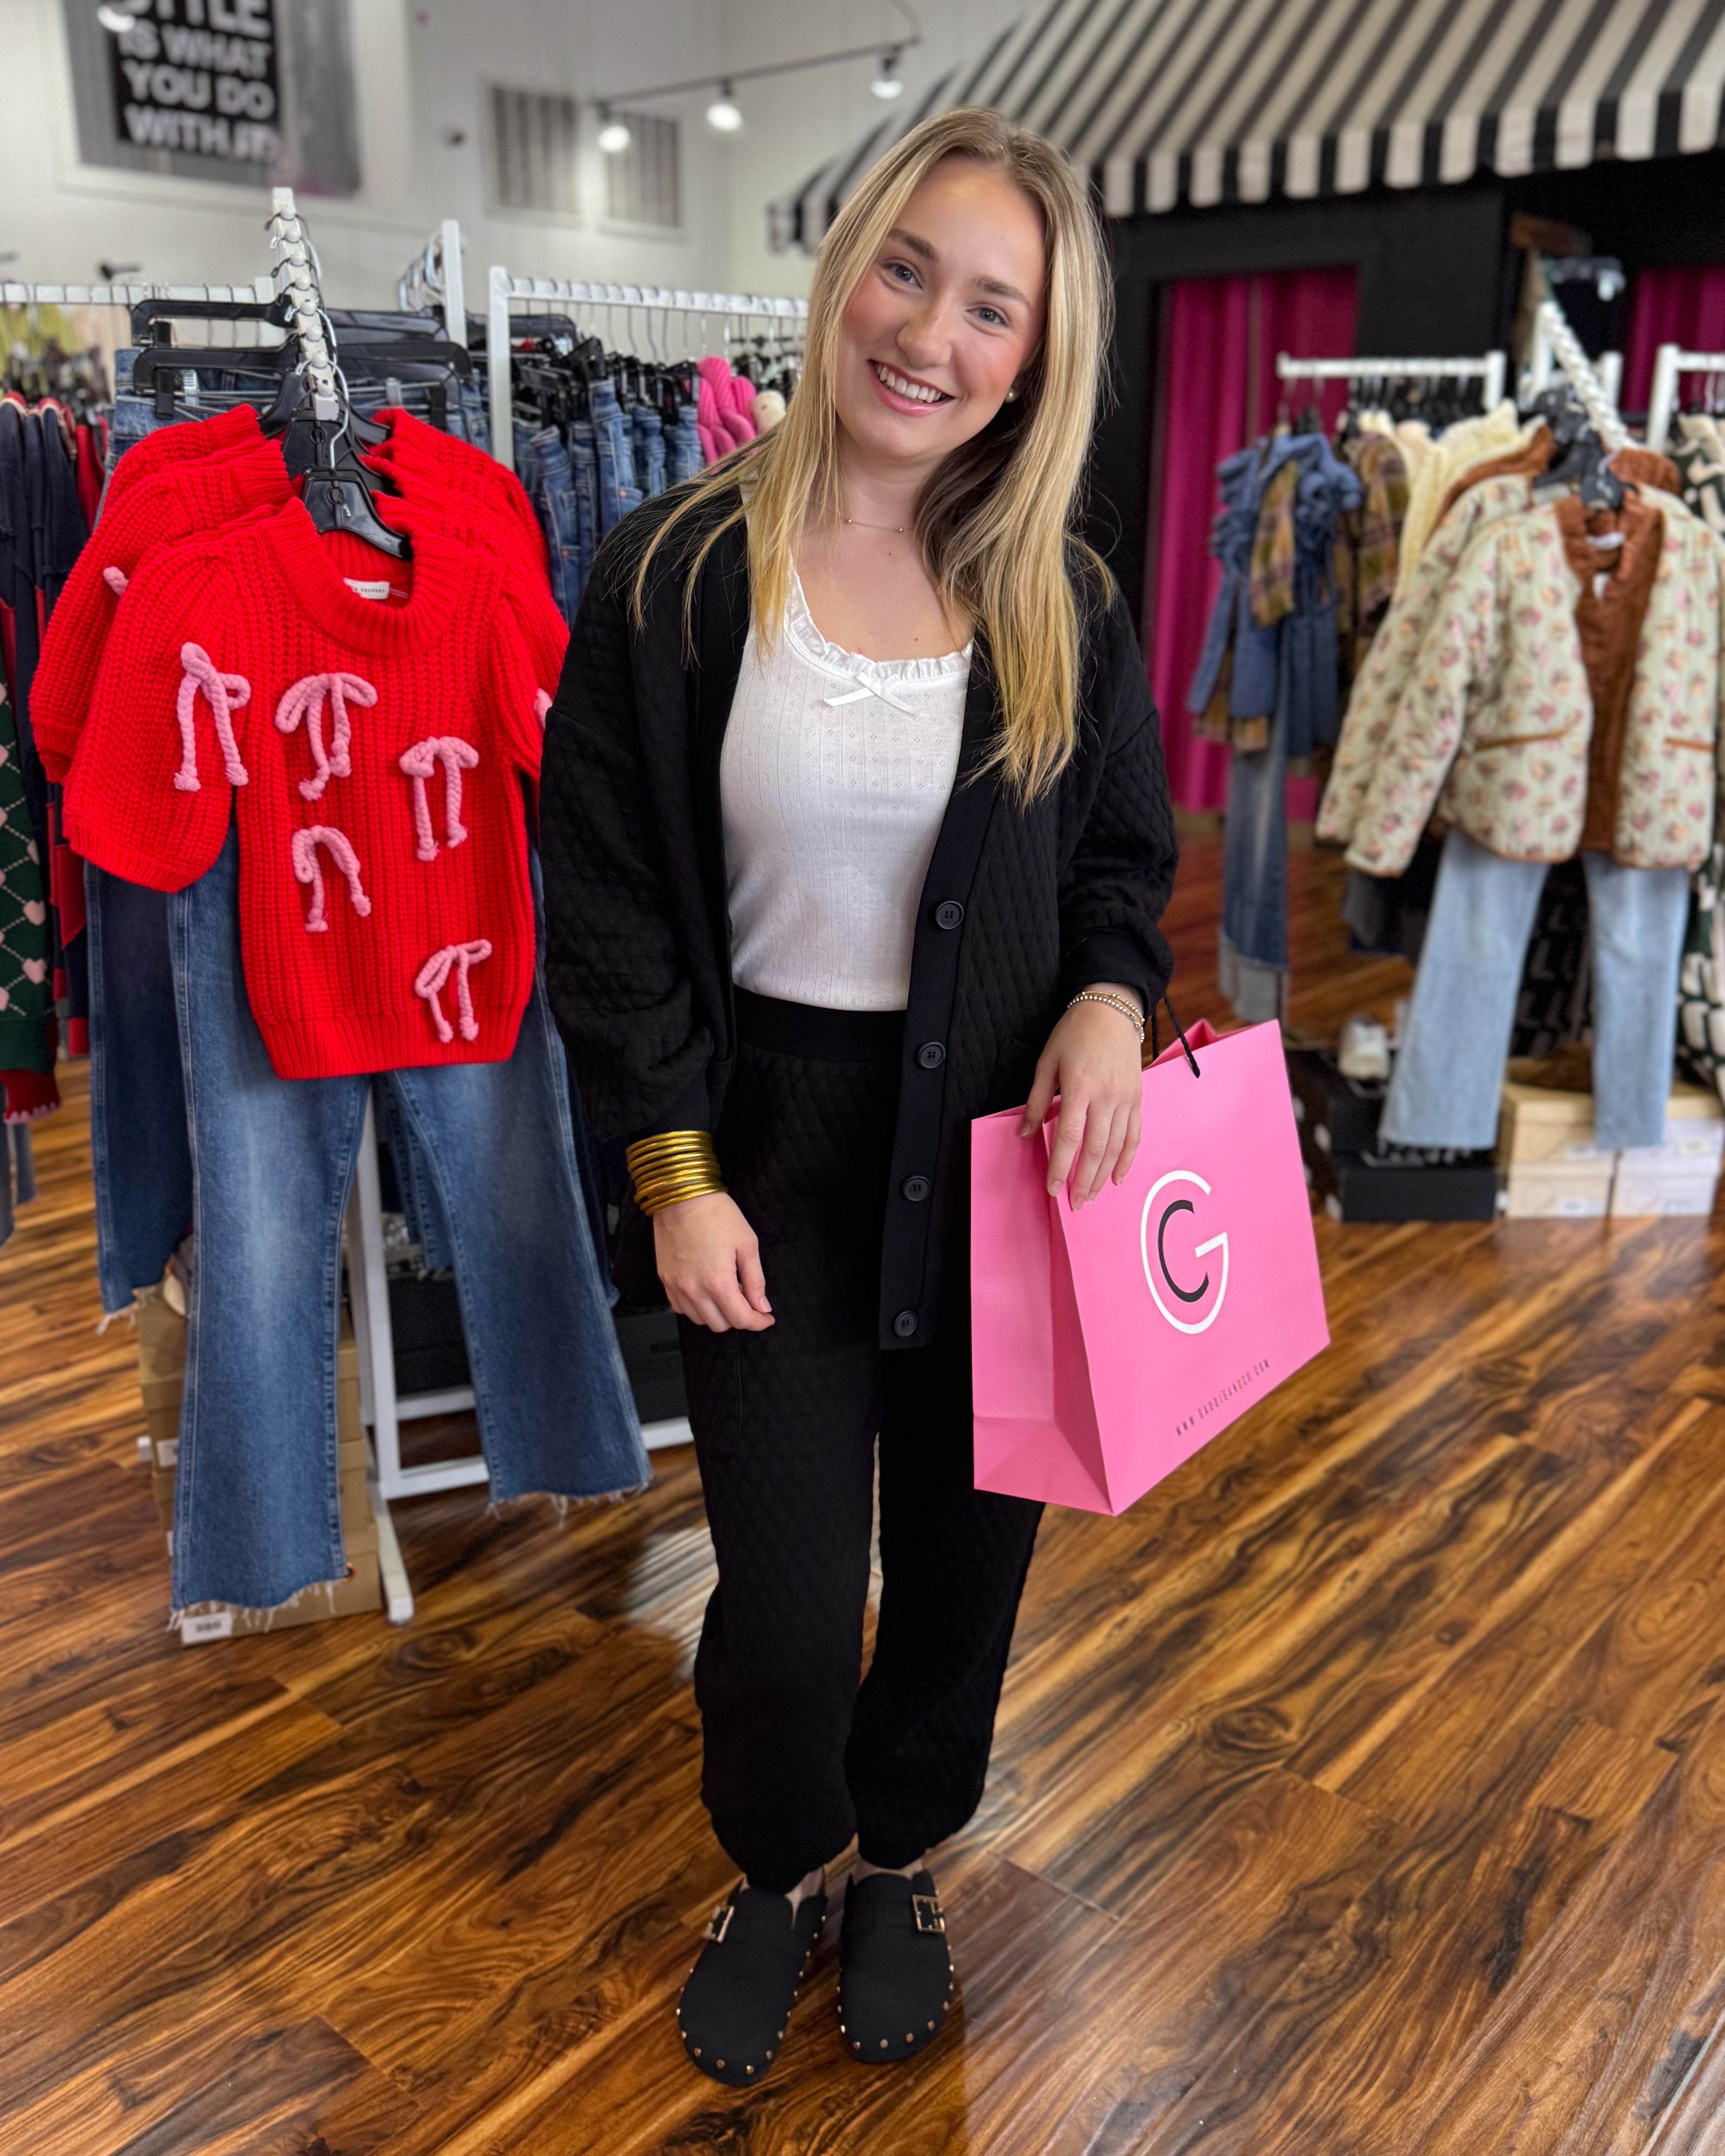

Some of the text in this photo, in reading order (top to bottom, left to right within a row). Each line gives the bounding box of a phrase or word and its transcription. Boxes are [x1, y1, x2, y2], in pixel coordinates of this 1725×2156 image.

[160, 23, 273, 78] WHAT
[120, 58, 275, 120] YOU DO
[123, 102, 231, 156] WITH
